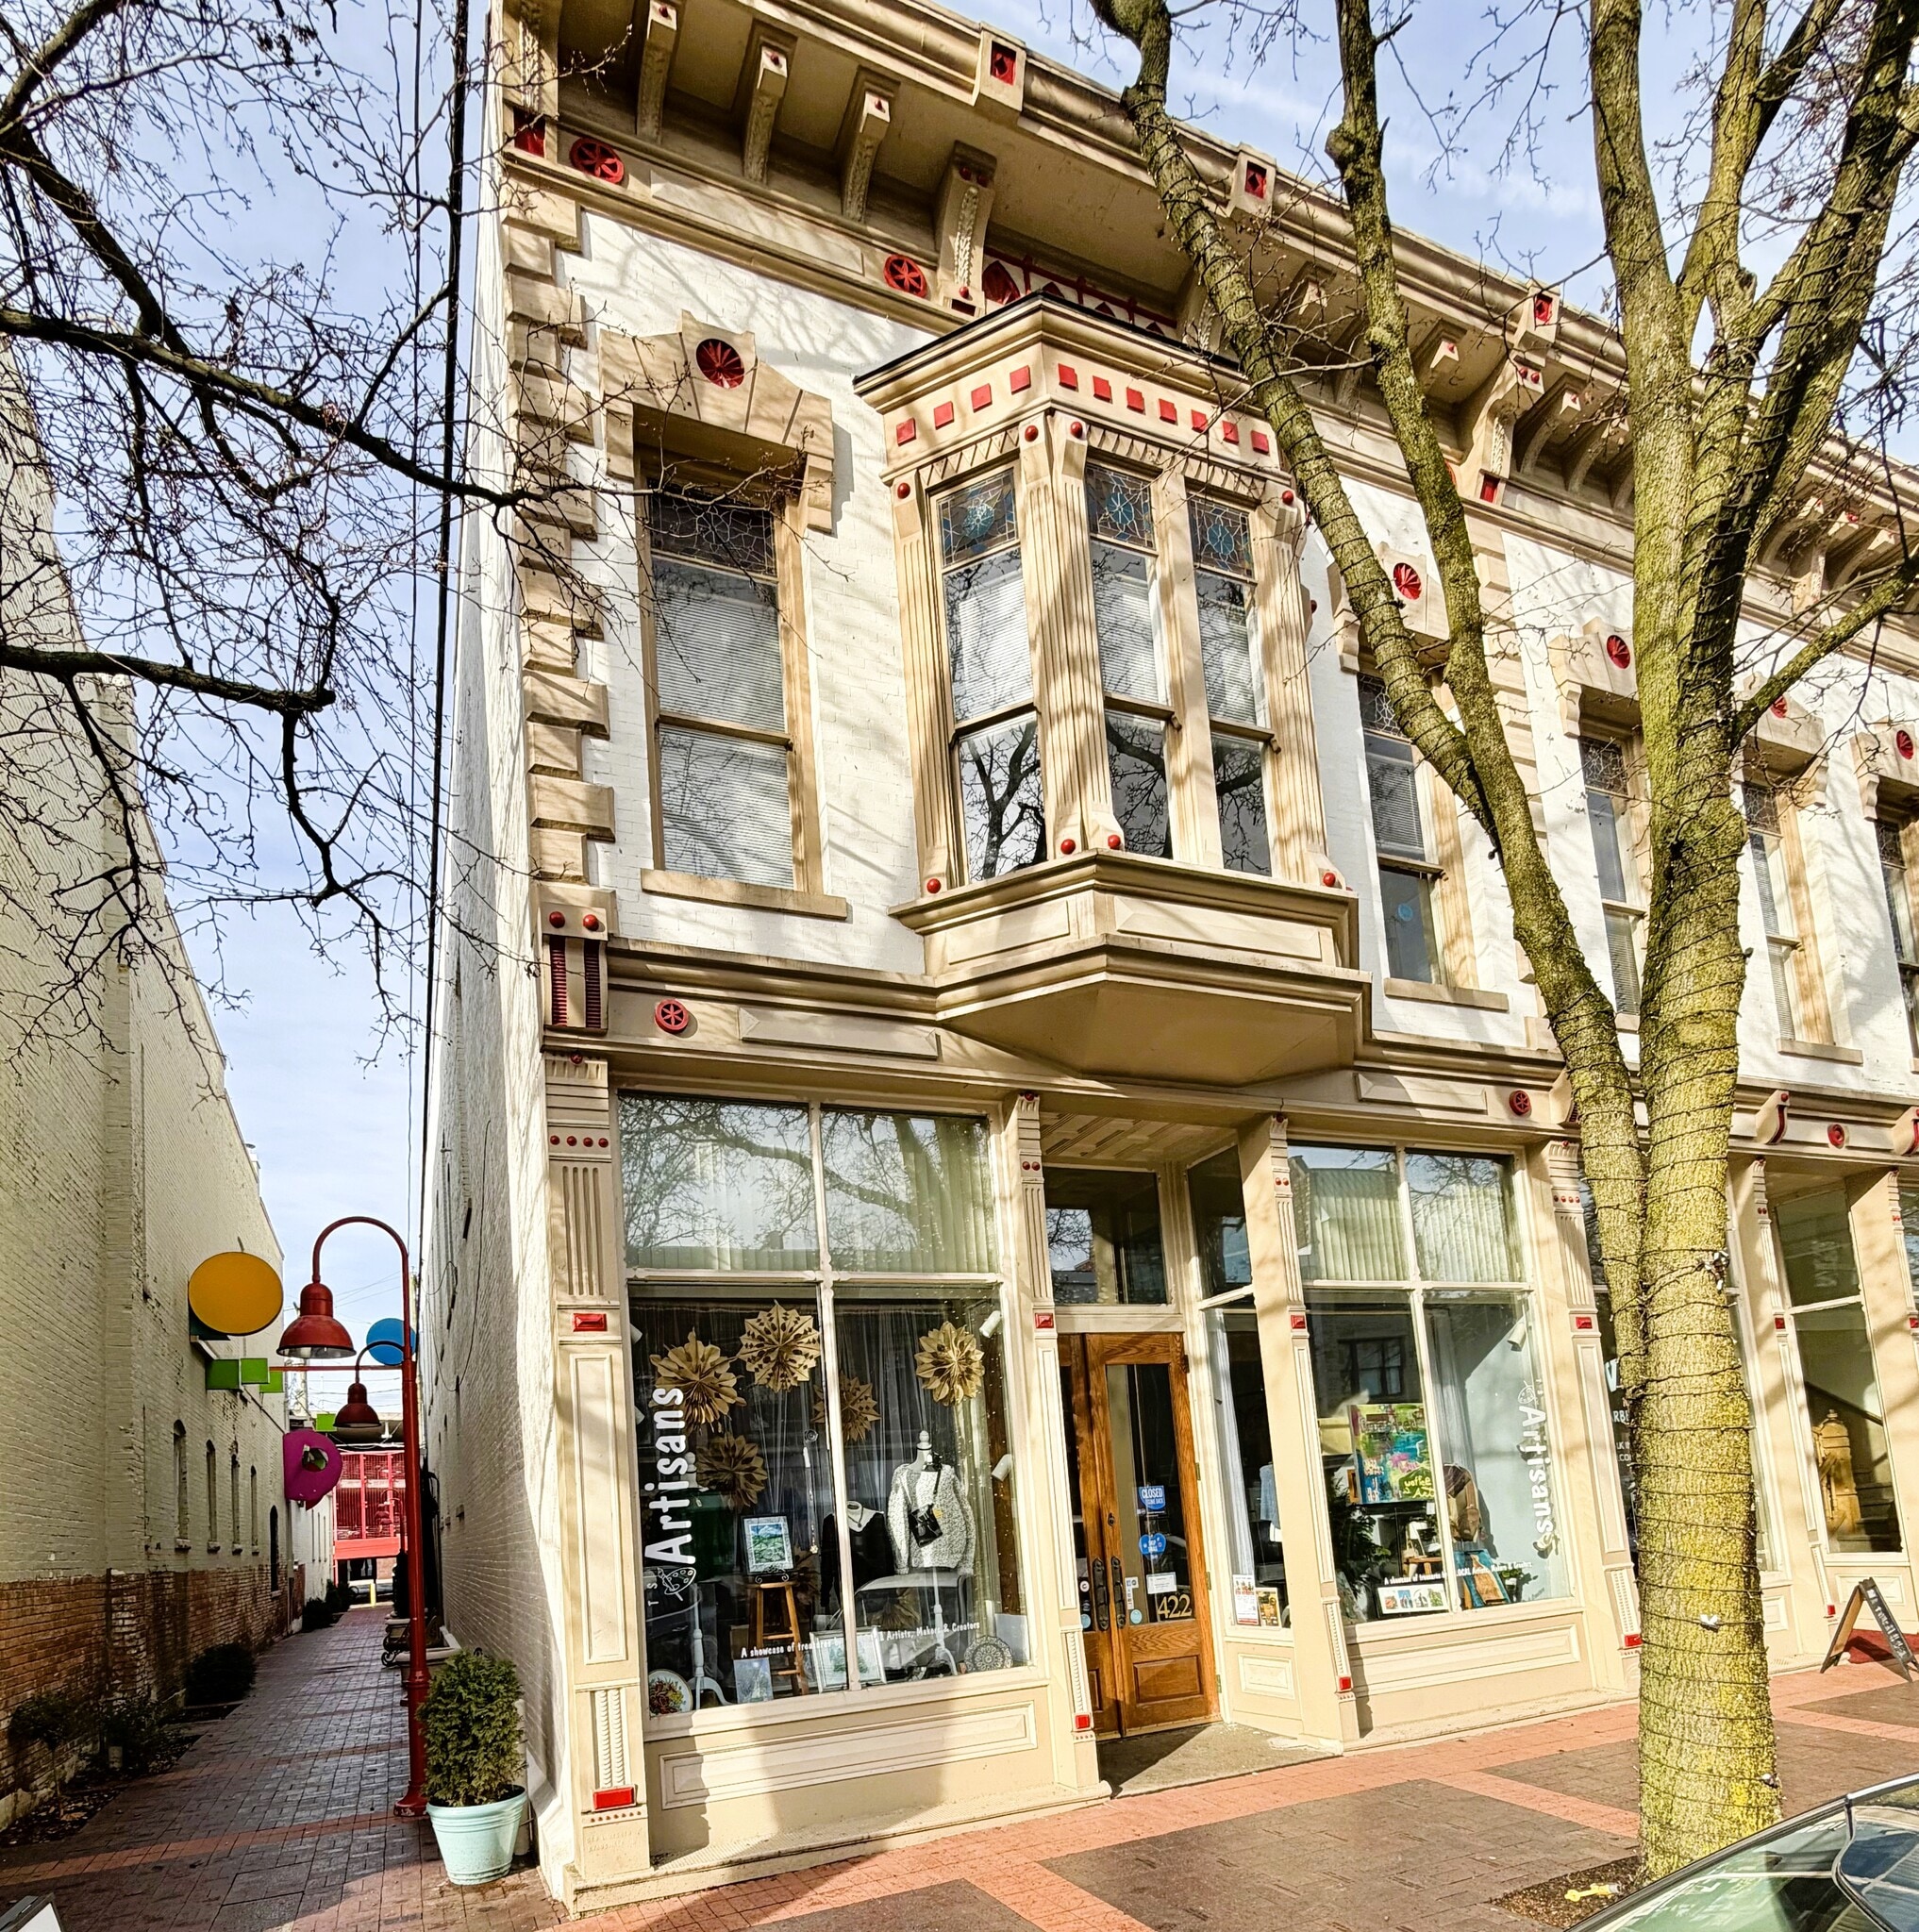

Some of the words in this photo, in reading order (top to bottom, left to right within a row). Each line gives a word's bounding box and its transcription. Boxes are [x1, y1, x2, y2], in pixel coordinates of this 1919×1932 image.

[644, 1388, 696, 1564] Artisans
[1519, 1406, 1554, 1533] Artisans
[1141, 1488, 1163, 1499] CLOSED
[1158, 1593, 1193, 1619] 422
[741, 1647, 747, 1658] A
[750, 1645, 784, 1657] showcase
[787, 1641, 795, 1653] of
[887, 1629, 914, 1641] Artists,
[943, 1623, 950, 1633] &
[952, 1621, 980, 1633] Creators
